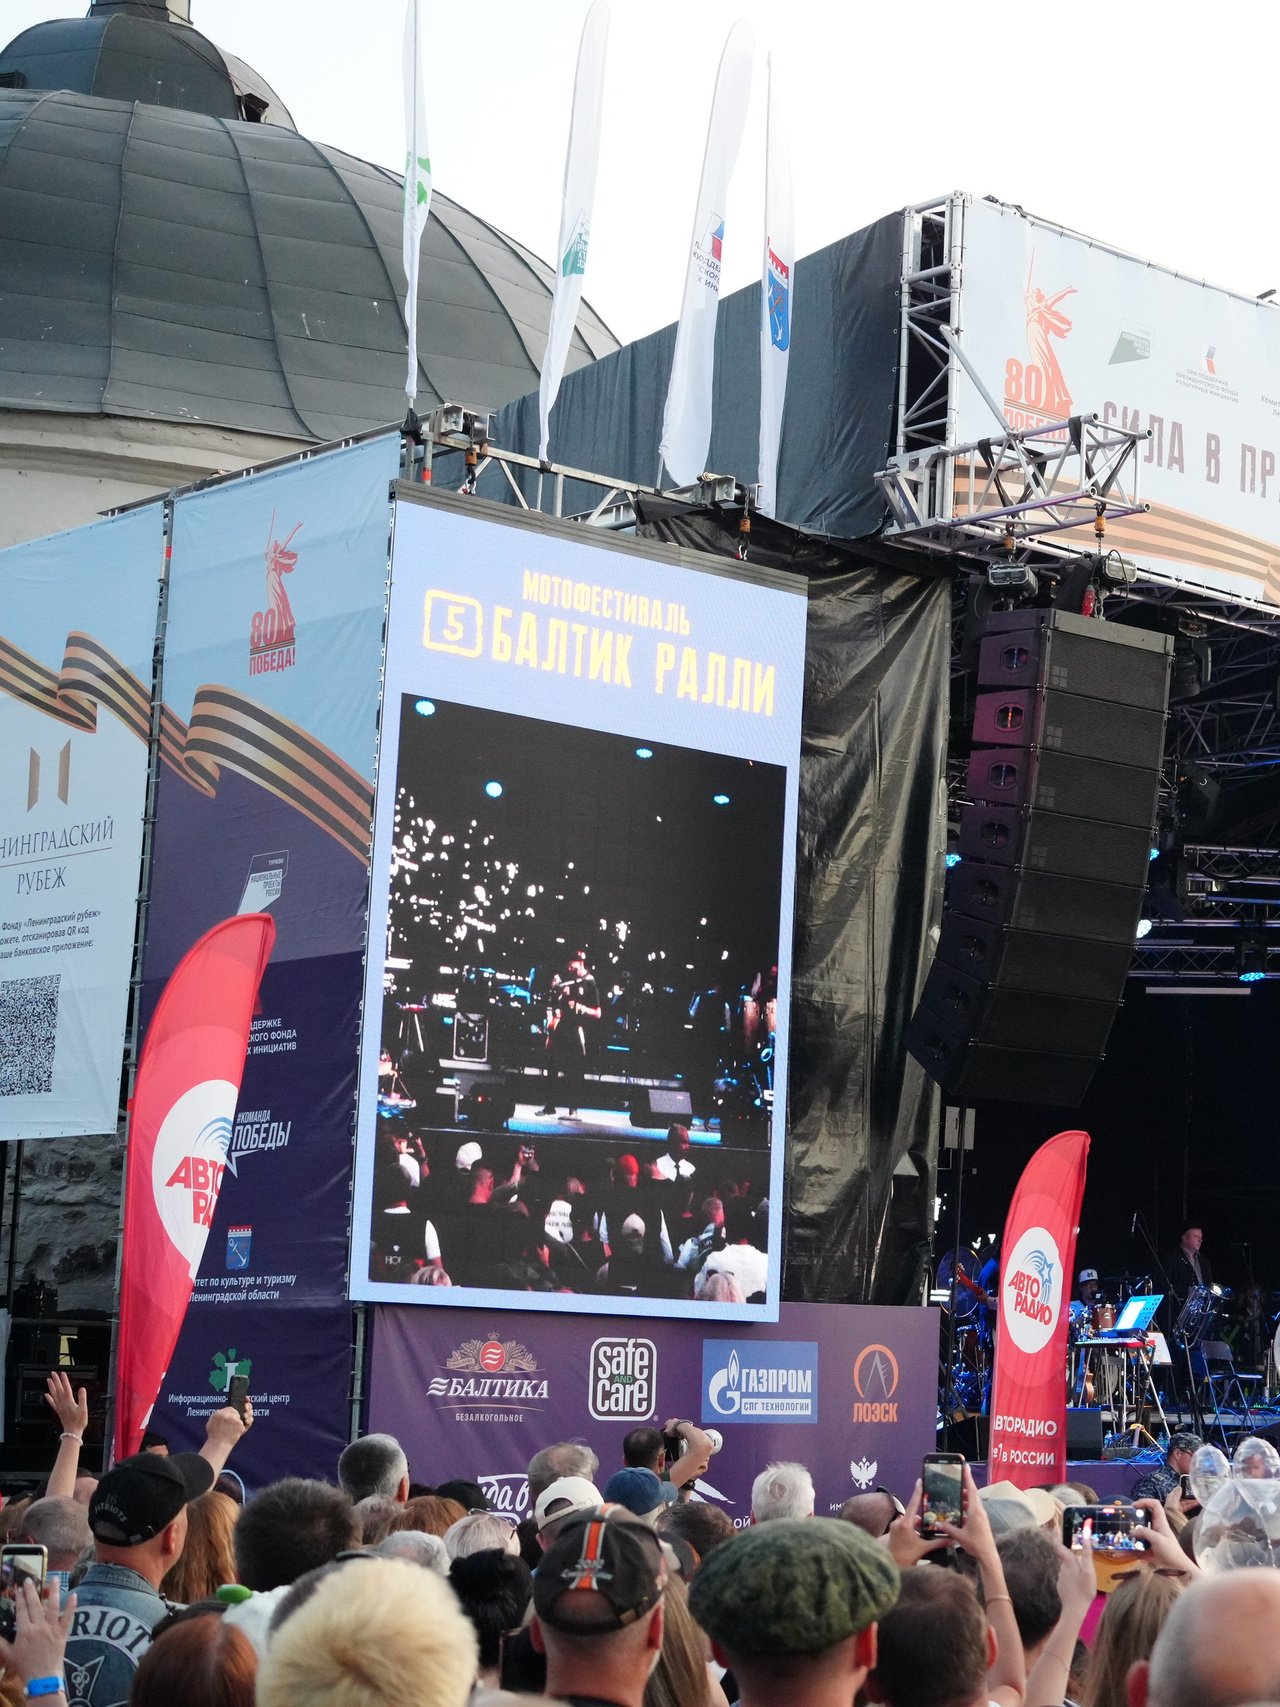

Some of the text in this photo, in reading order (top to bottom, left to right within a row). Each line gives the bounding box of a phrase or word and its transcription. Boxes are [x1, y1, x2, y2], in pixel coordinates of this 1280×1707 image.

[1005, 358, 1042, 409] 80
[1206, 432, 1221, 485] В
[523, 570, 690, 636] МОТОФЕСТИВАЛЬ
[250, 608, 276, 649] 80
[249, 646, 296, 676] ПОБЕДА!
[491, 606, 634, 688] БАЛТИК
[655, 642, 776, 717] РАЛЛИ
[17, 866, 68, 895] РУБЕЖ
[2, 921, 22, 931] Фонду
[22, 929, 66, 943] отсканировав
[77, 925, 90, 935] код
[14, 946, 51, 958] банковское
[270, 1029, 297, 1041] ФОНДА
[253, 1041, 297, 1056] ИНИЦИАТИВ
[237, 1109, 271, 1124] #КОМАНДА
[232, 1121, 292, 1151] ПОБЕДЫ
[209, 1278, 219, 1287] по
[220, 1276, 255, 1289] культуре
[264, 1274, 297, 1287] туризму
[1008, 1270, 1040, 1298] АВТО
[189, 1288, 280, 1304] Ленинградской области
[1014, 1291, 1053, 1325] РАДИО
[447, 1378, 549, 1399] БАЛТИКА
[613, 1375, 633, 1384] AND
[742, 1369, 812, 1393] ГАЗПРОМ
[269, 1394, 290, 1405] центр
[743, 1402, 810, 1411] СПГ ТЕХНОЛОГИИ
[455, 1412, 524, 1422] БЕЗАЛКОГОЛЬНОЕ
[853, 1402, 898, 1423] ЛОЭСК
[994, 1415, 1058, 1437] ВТОРАДИО
[1010, 1450, 1055, 1465] РОССИИ
